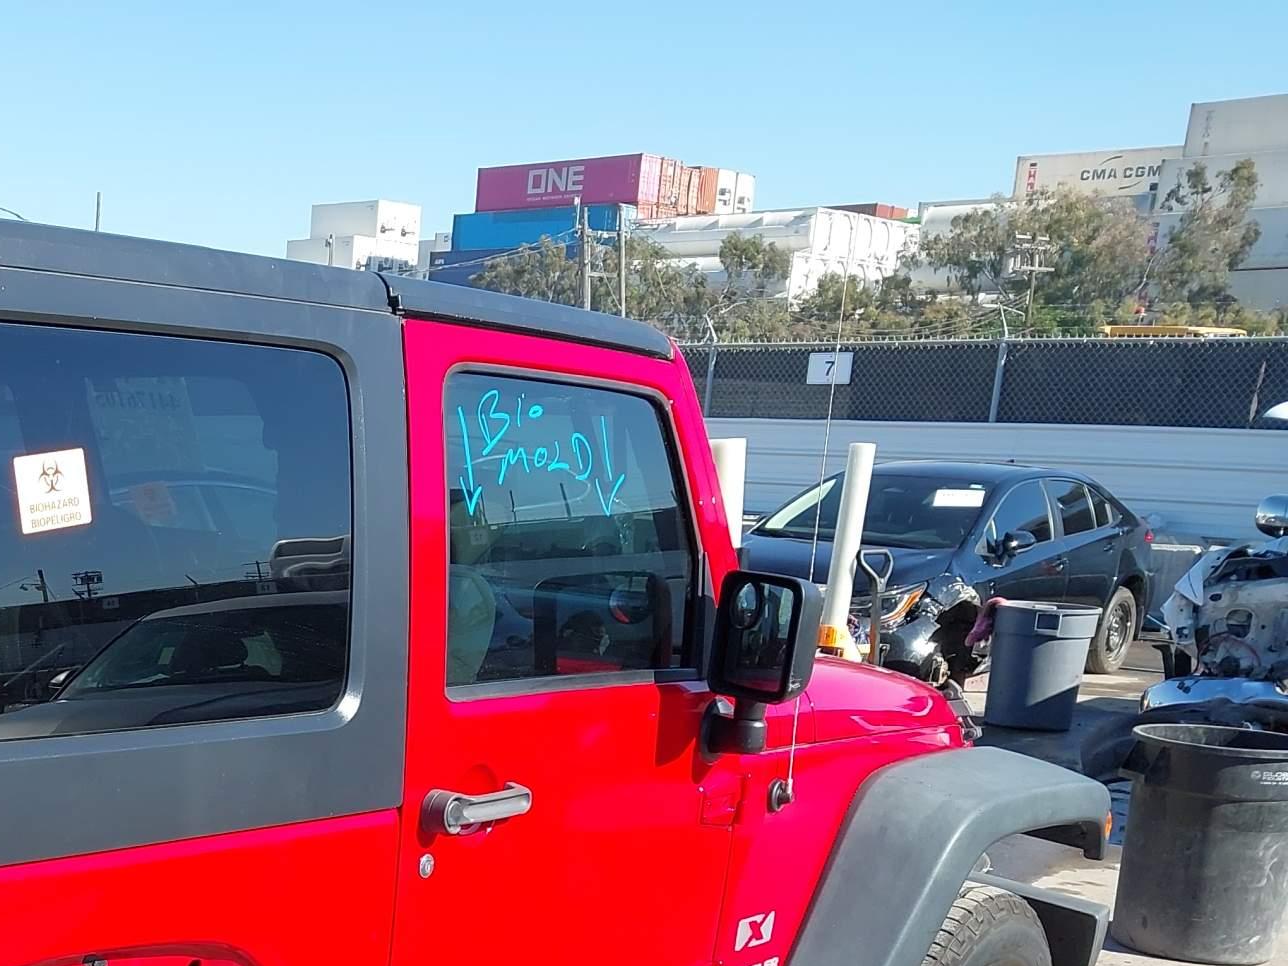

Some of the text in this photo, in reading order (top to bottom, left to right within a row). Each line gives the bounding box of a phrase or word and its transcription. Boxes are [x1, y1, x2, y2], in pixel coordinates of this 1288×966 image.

[527, 165, 585, 194] ONE
[1080, 164, 1161, 181] CMA CGM
[824, 360, 836, 376] 7
[29, 496, 80, 514] BIOHAZARD
[30, 511, 82, 530] BIOPELIGRO
